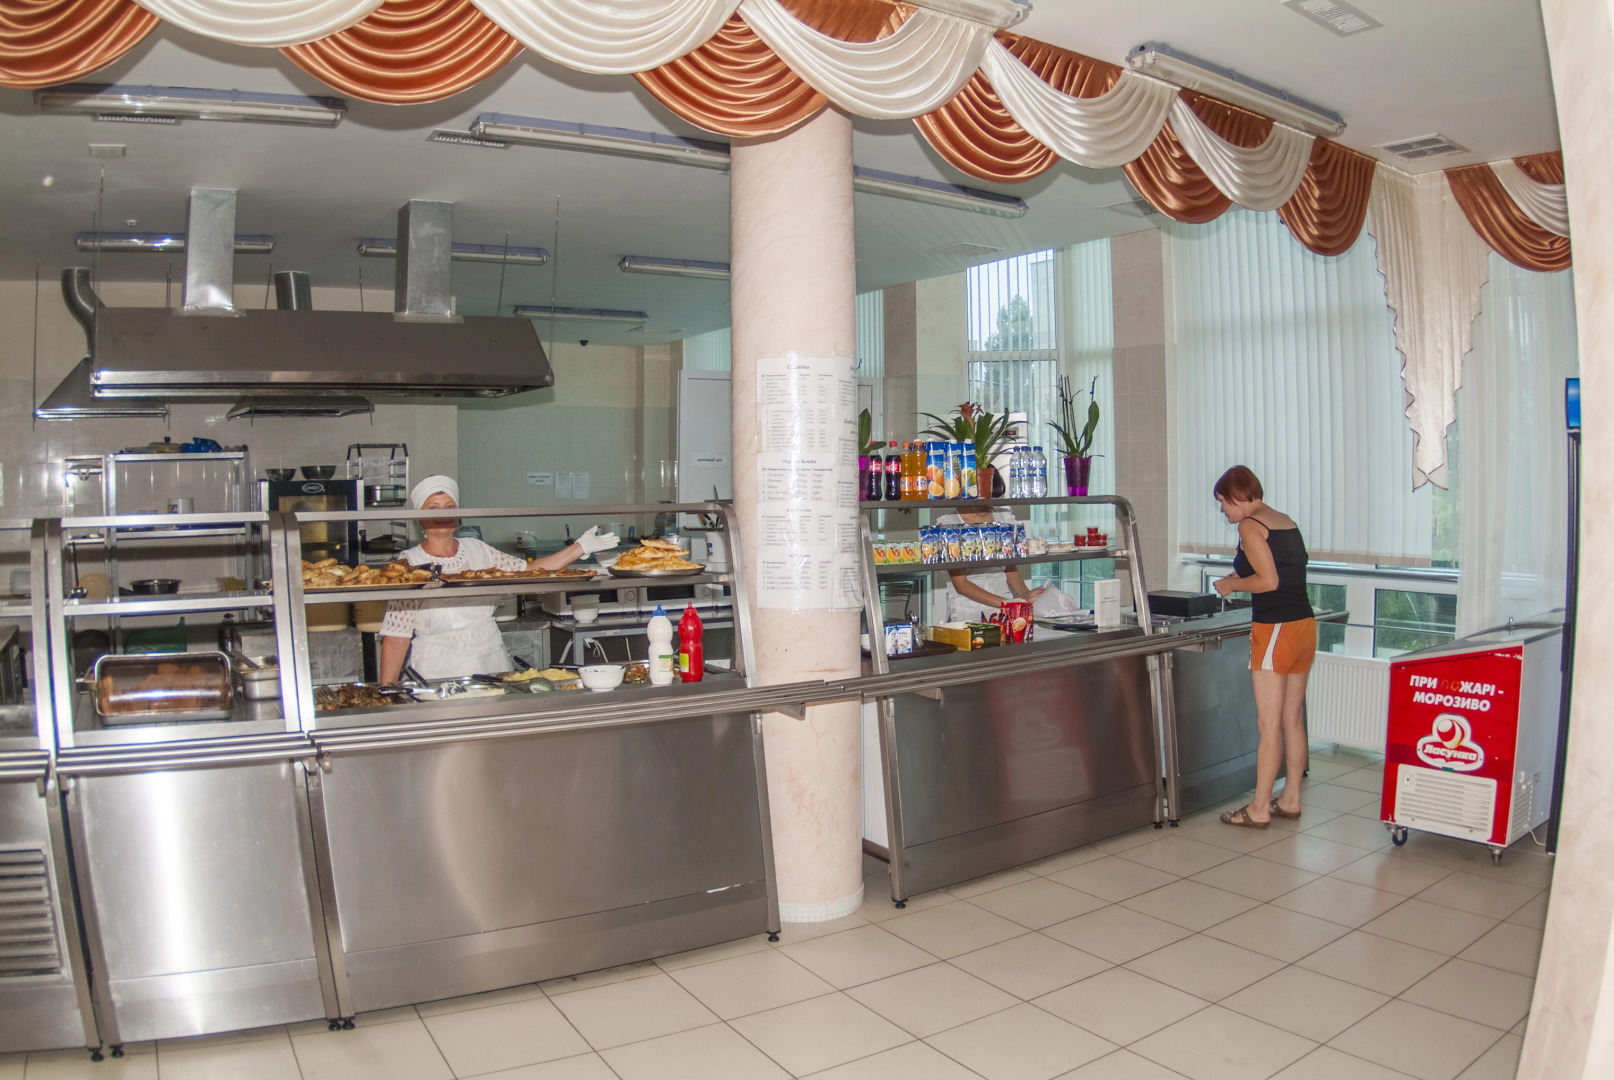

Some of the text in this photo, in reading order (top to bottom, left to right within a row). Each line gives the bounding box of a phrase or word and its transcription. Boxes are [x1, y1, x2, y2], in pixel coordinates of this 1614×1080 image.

[1409, 675, 1438, 689] ПРИ
[1412, 691, 1491, 712] МОРОЗИВО
[1423, 744, 1477, 761] Ласунка
